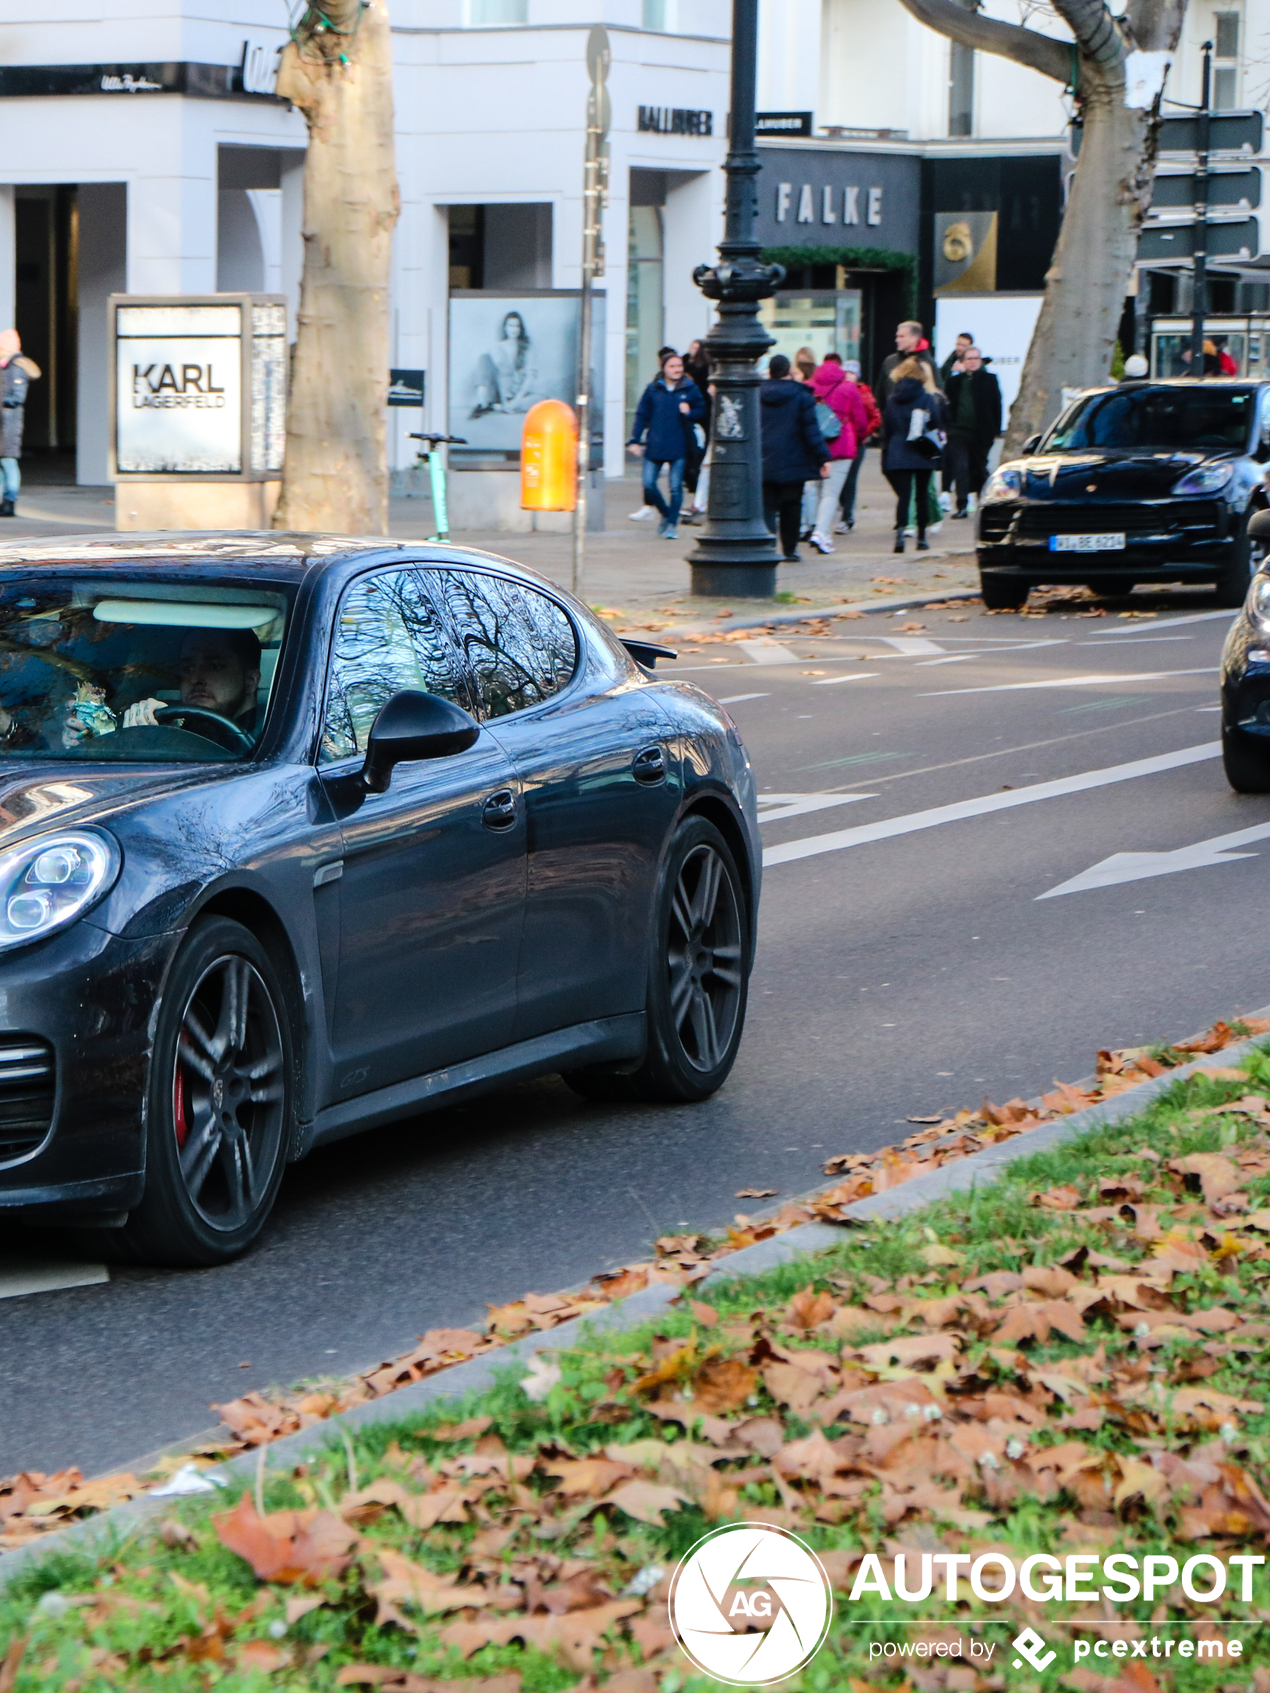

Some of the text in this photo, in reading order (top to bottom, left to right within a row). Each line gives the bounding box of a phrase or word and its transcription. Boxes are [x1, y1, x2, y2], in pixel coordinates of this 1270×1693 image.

[242, 41, 282, 95] Ull
[776, 183, 882, 226] FALKE
[133, 364, 225, 393] KARL
[133, 396, 226, 409] LAGERFELD
